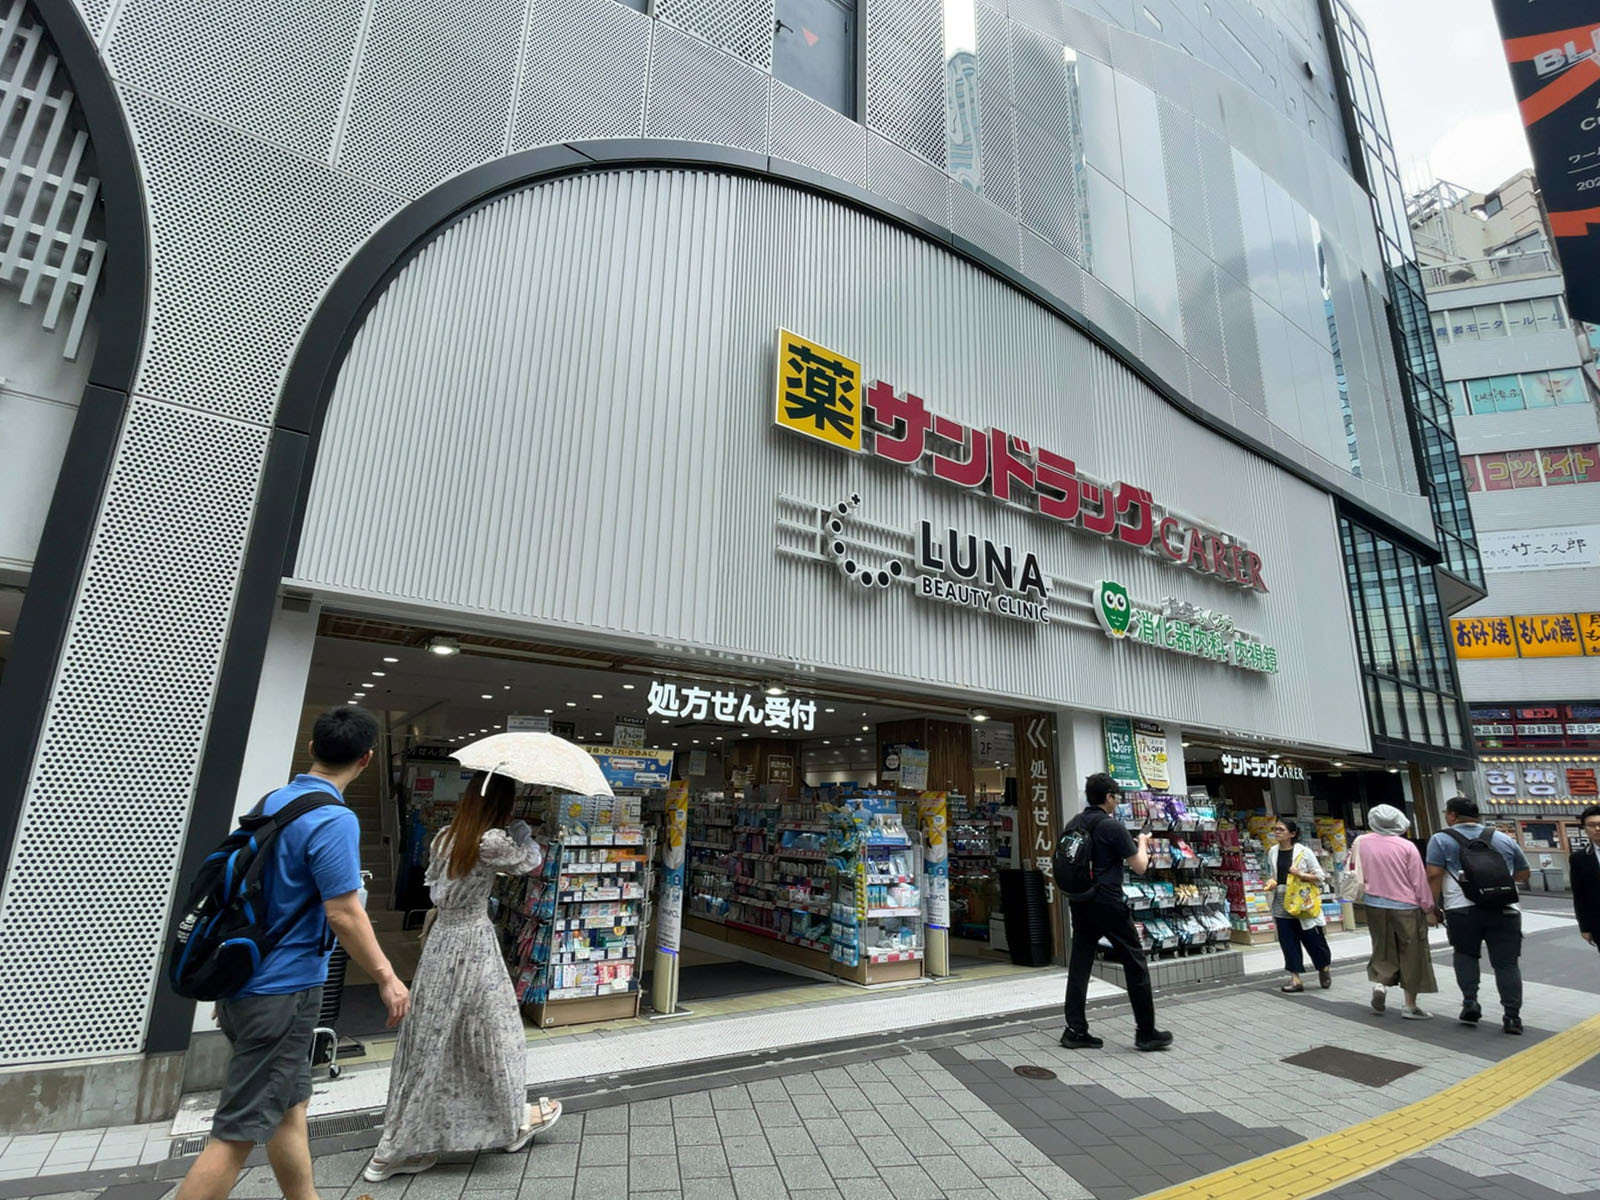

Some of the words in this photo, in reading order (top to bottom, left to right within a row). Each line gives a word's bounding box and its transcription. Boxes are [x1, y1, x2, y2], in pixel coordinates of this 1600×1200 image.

[784, 343, 855, 439] 薬
[868, 380, 1154, 547] サンドラッグ
[1160, 516, 1269, 593] CARER
[921, 520, 1048, 599] LUNA
[922, 576, 990, 608] BEAUTY
[998, 596, 1049, 623] CLINIC
[647, 681, 817, 731] 処方せん受付
[1221, 754, 1277, 778] サンドラッグ
[1277, 765, 1305, 780] CARER
